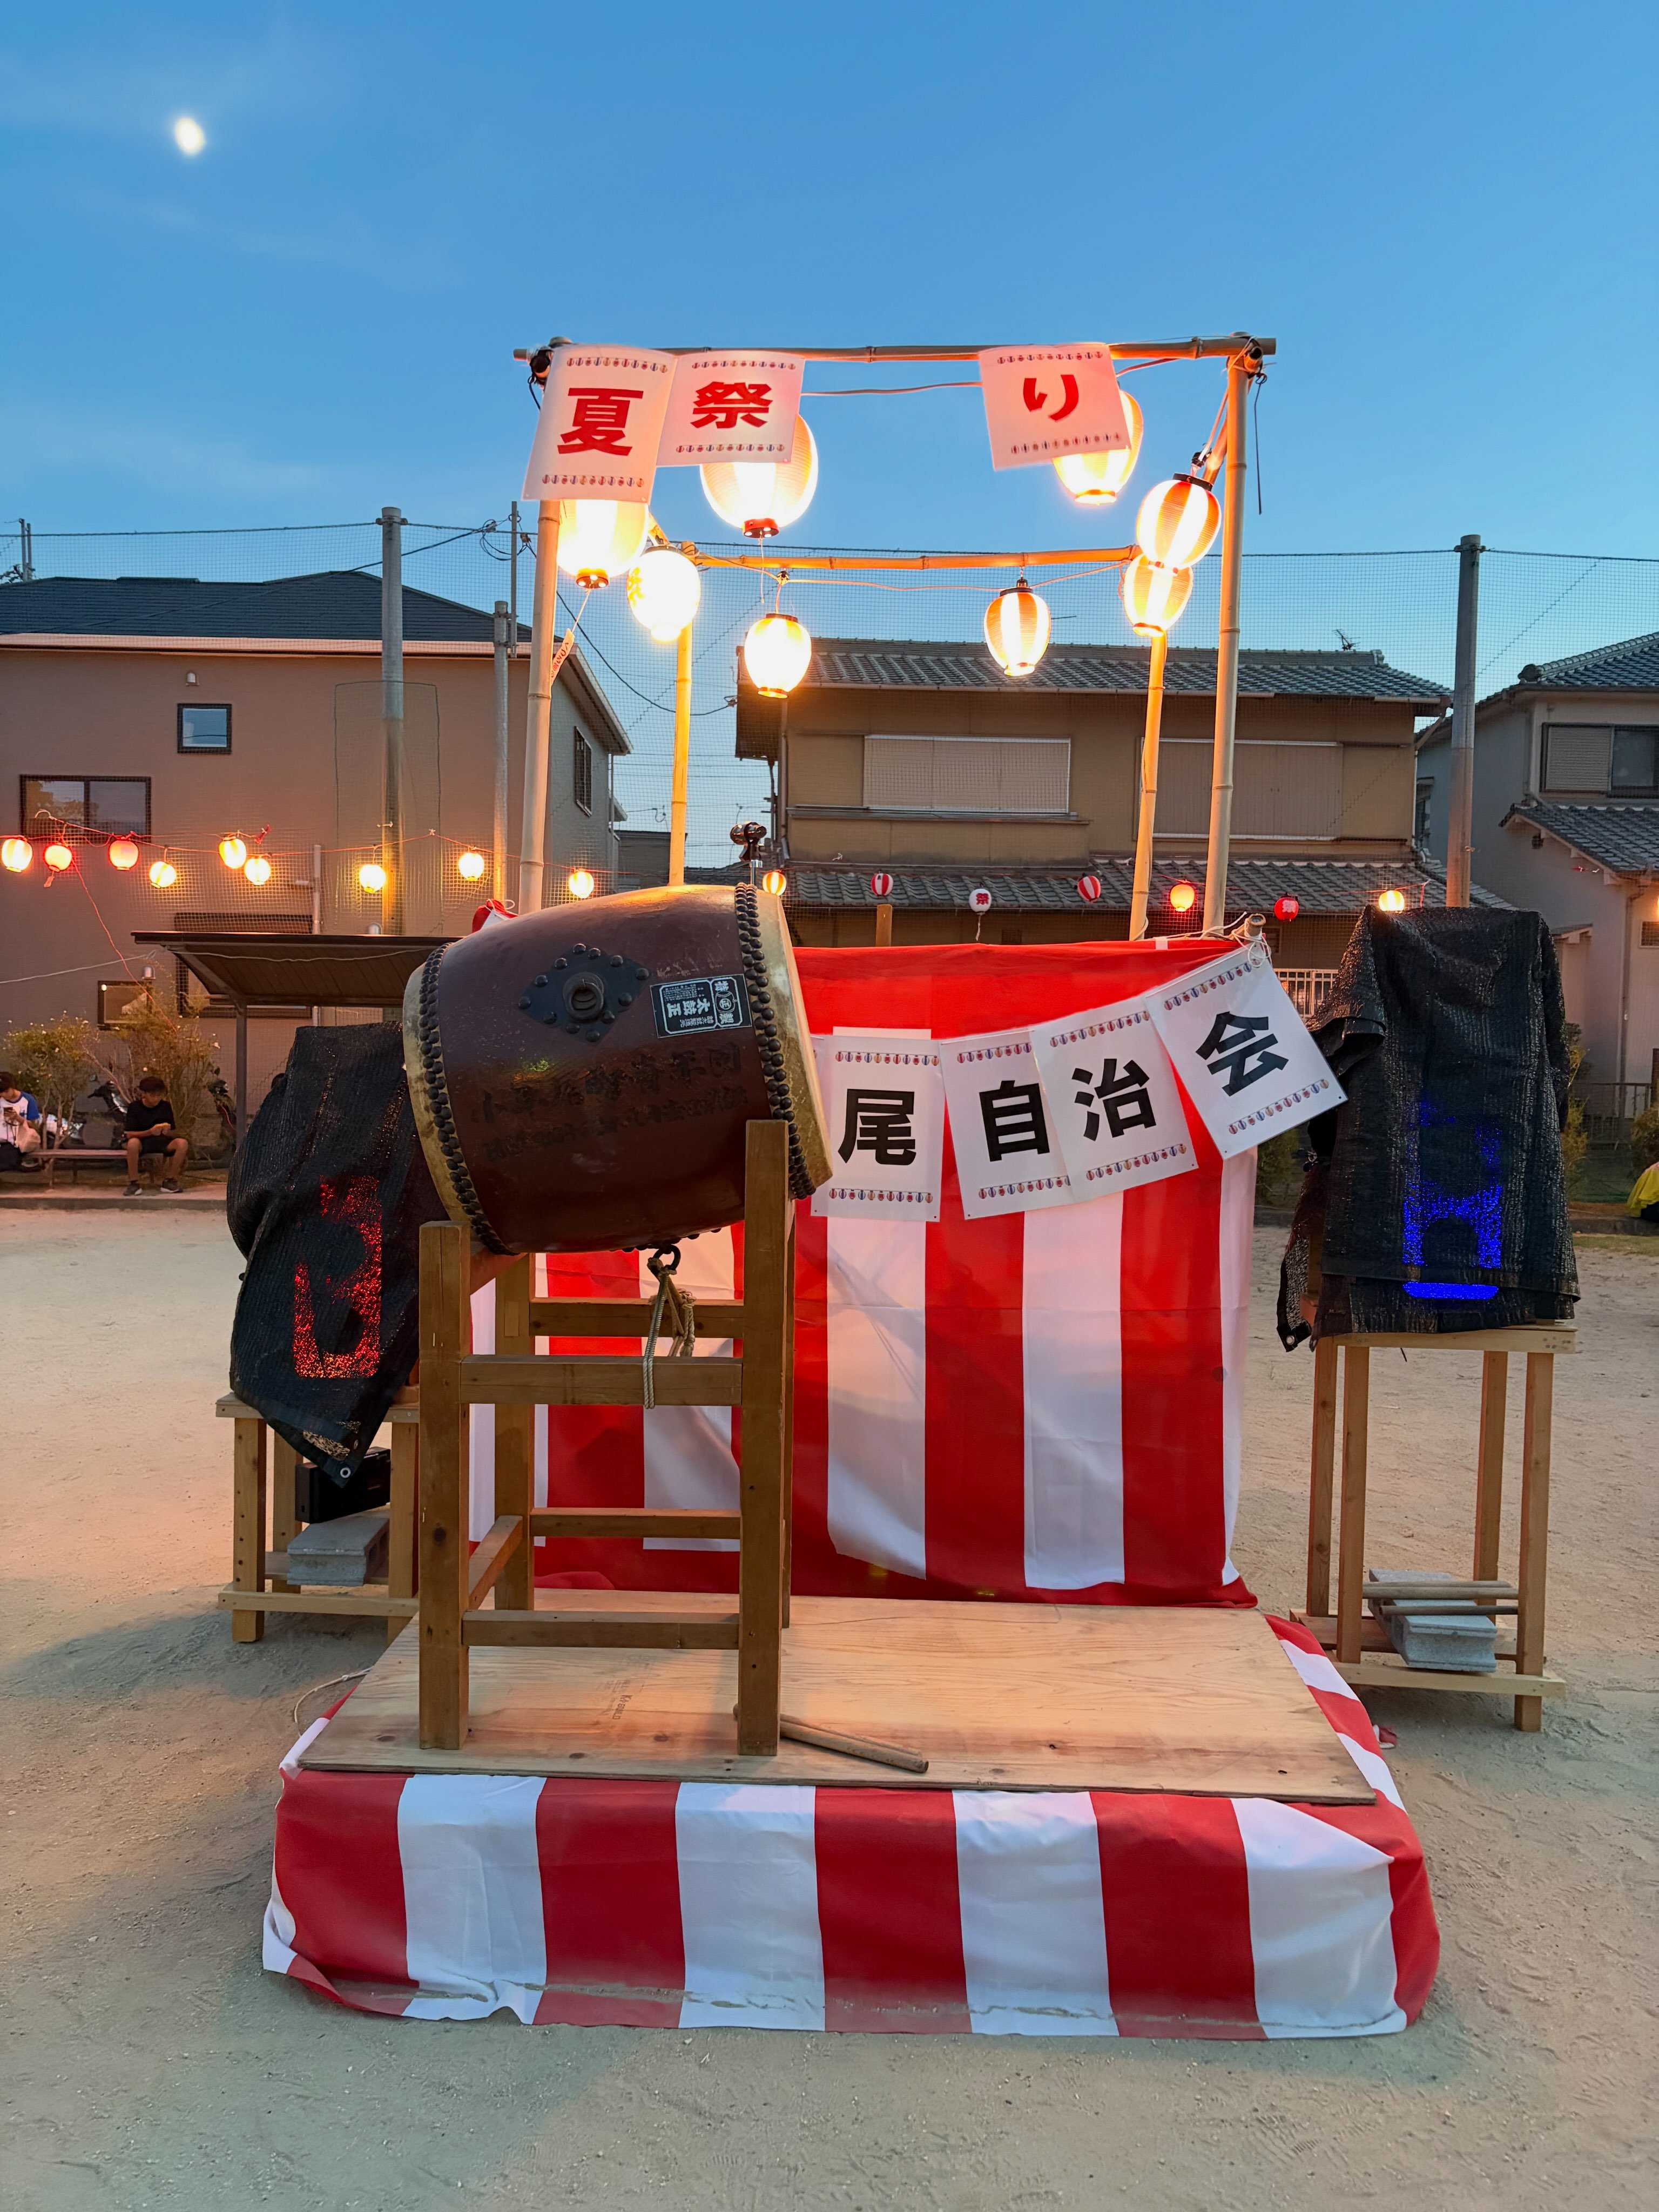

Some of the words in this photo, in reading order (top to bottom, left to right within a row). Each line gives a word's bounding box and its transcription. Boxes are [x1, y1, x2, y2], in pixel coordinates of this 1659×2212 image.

[976, 893, 989, 905] 祭
[666, 998, 710, 1018] 太鼓正
[838, 1011, 1289, 1165] 尾自治会
